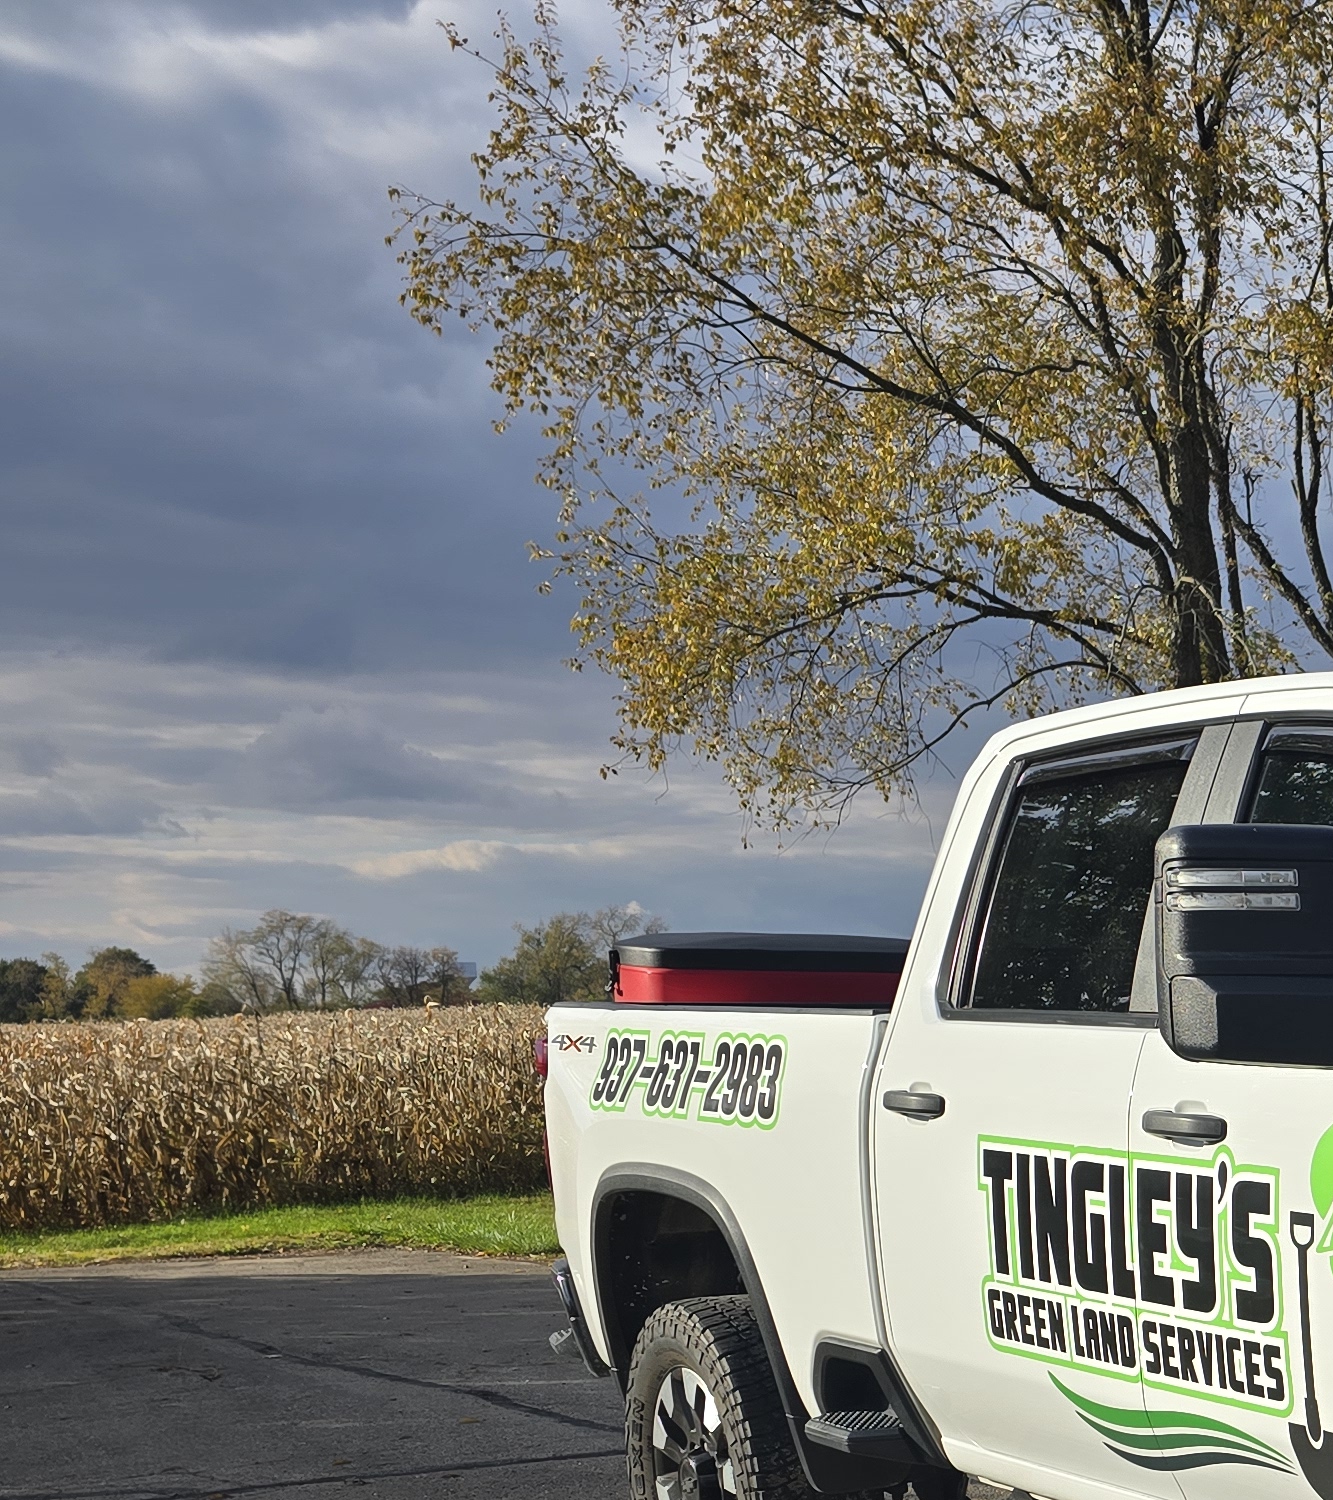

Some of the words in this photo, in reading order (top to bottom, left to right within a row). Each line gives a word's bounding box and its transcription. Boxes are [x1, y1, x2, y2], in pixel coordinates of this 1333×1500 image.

[591, 1036, 784, 1120] 937-631-2983
[982, 1148, 1275, 1324] TINGLEY'S
[987, 1288, 1068, 1354] GREEN
[1070, 1304, 1137, 1369] LAND
[1141, 1319, 1286, 1402] SERVICES
